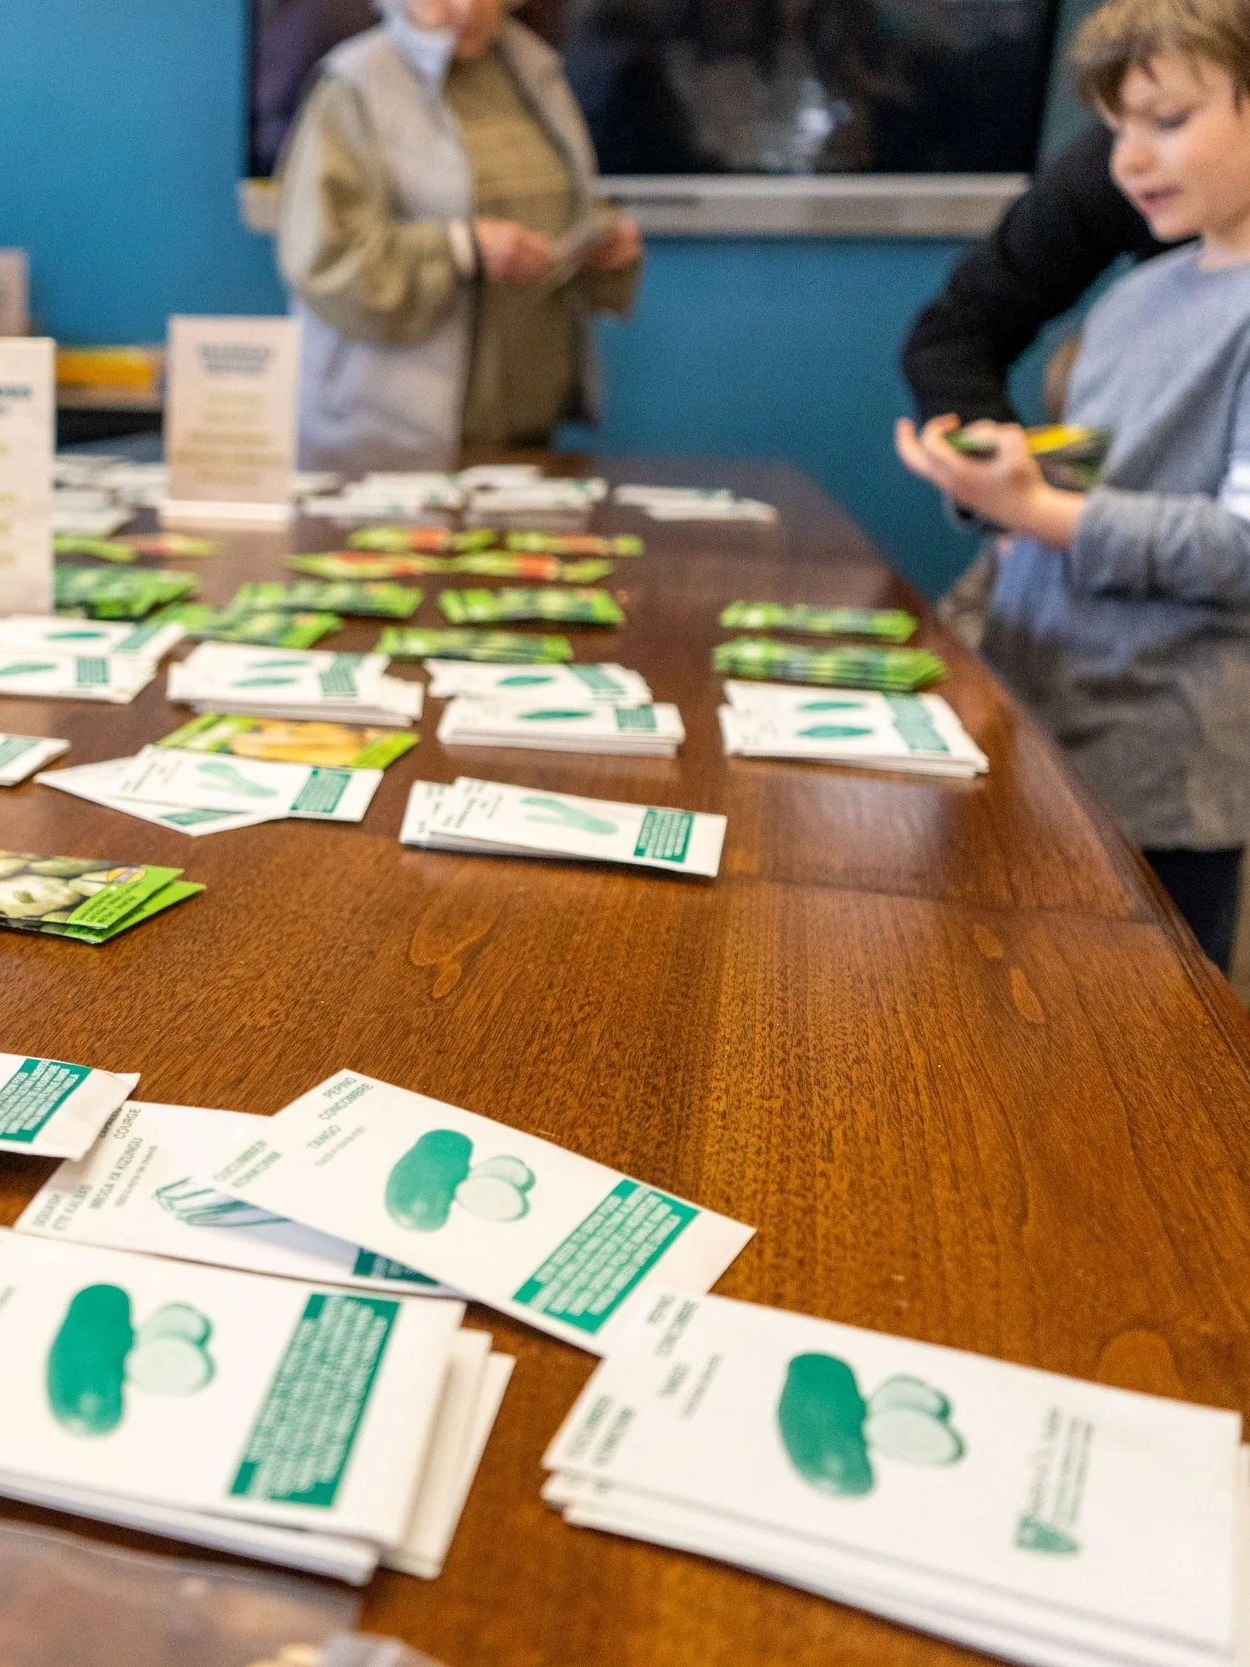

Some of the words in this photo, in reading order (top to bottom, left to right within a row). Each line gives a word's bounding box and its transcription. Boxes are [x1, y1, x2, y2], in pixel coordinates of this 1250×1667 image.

[322, 1077, 357, 1098] PEPINO
[318, 1083, 374, 1121] CONCOMBRE
[113, 1108, 141, 1140] COURGE
[306, 1124, 342, 1149] TANGO
